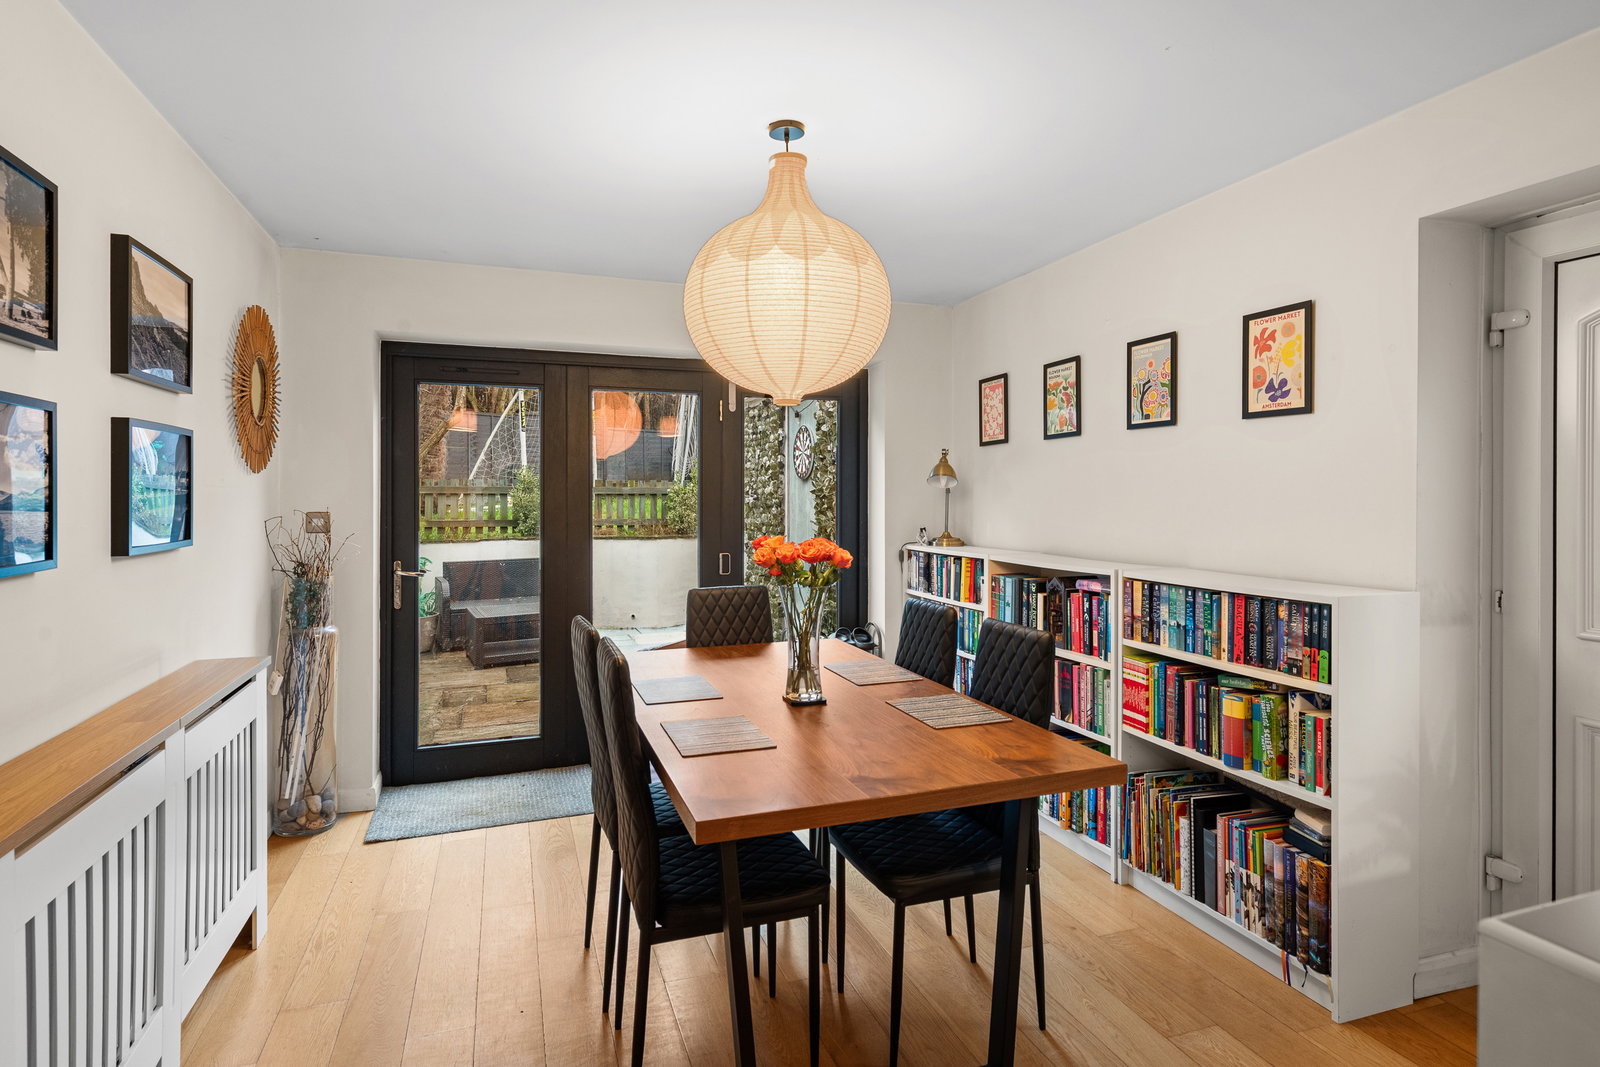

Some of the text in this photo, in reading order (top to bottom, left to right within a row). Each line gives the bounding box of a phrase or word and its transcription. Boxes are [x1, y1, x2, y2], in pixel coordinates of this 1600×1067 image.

[1254, 310, 1301, 326] FLOWER MARKET
[1264, 729, 1275, 759] SCIENCE
